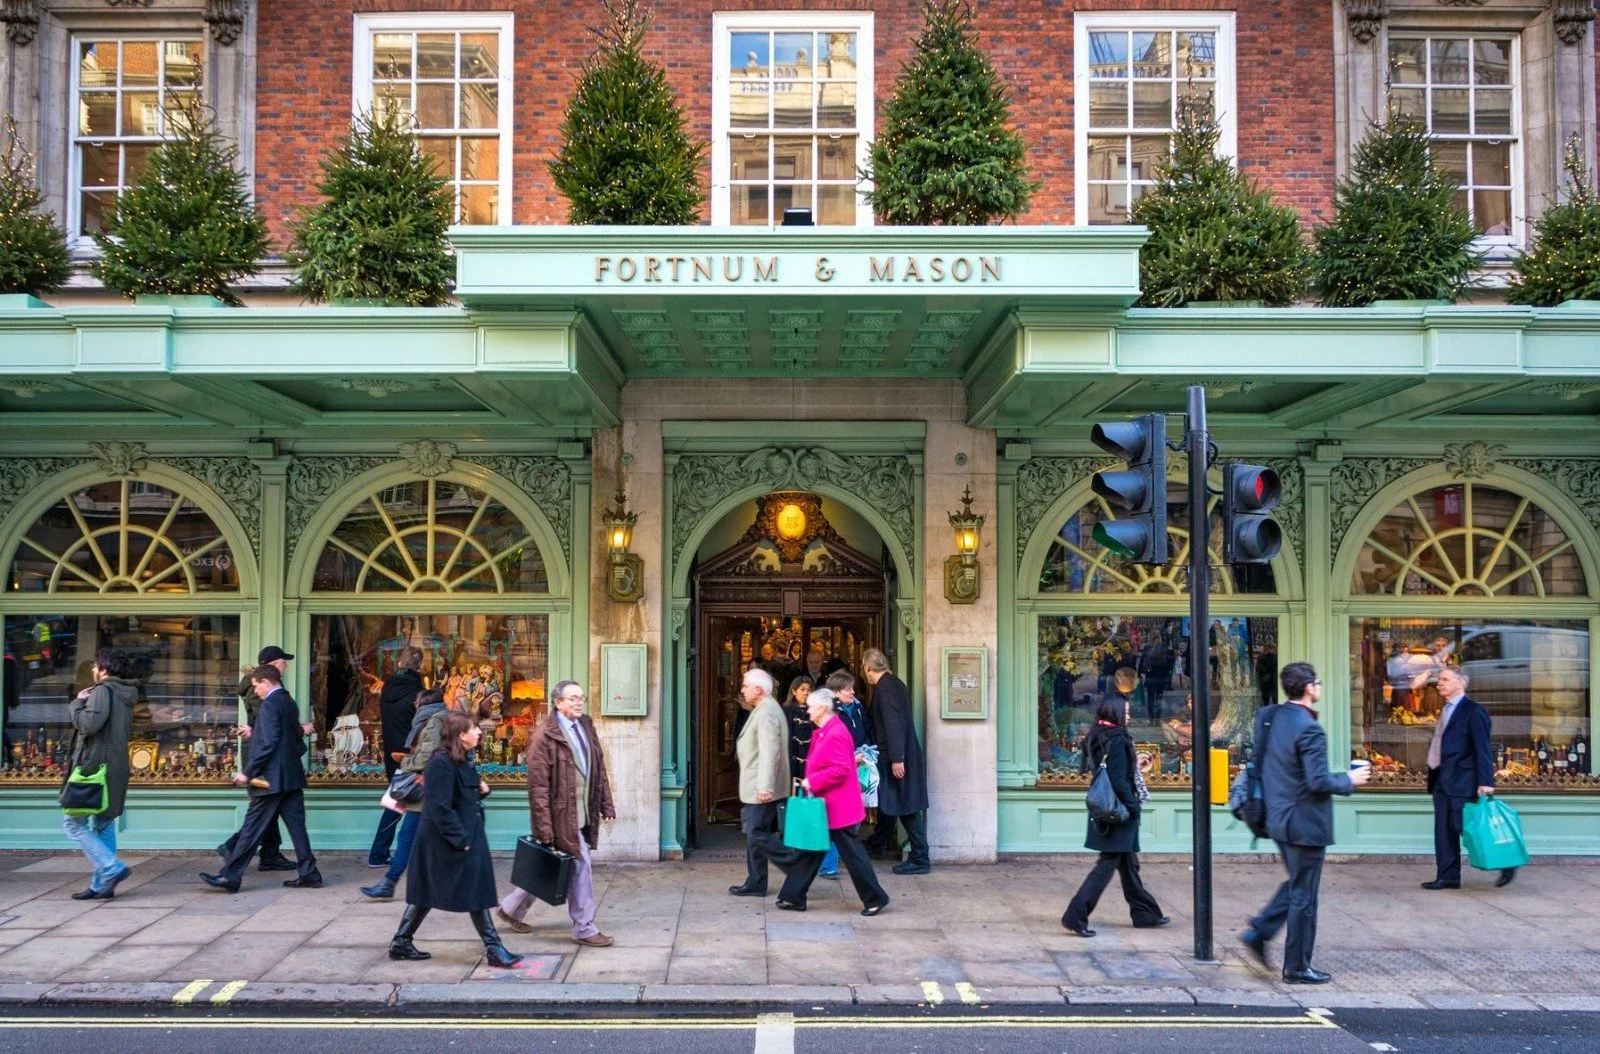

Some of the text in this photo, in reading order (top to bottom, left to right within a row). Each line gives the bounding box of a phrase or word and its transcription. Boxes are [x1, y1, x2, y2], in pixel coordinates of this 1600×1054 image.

[594, 255, 1002, 282] FORTNUM & MASON
